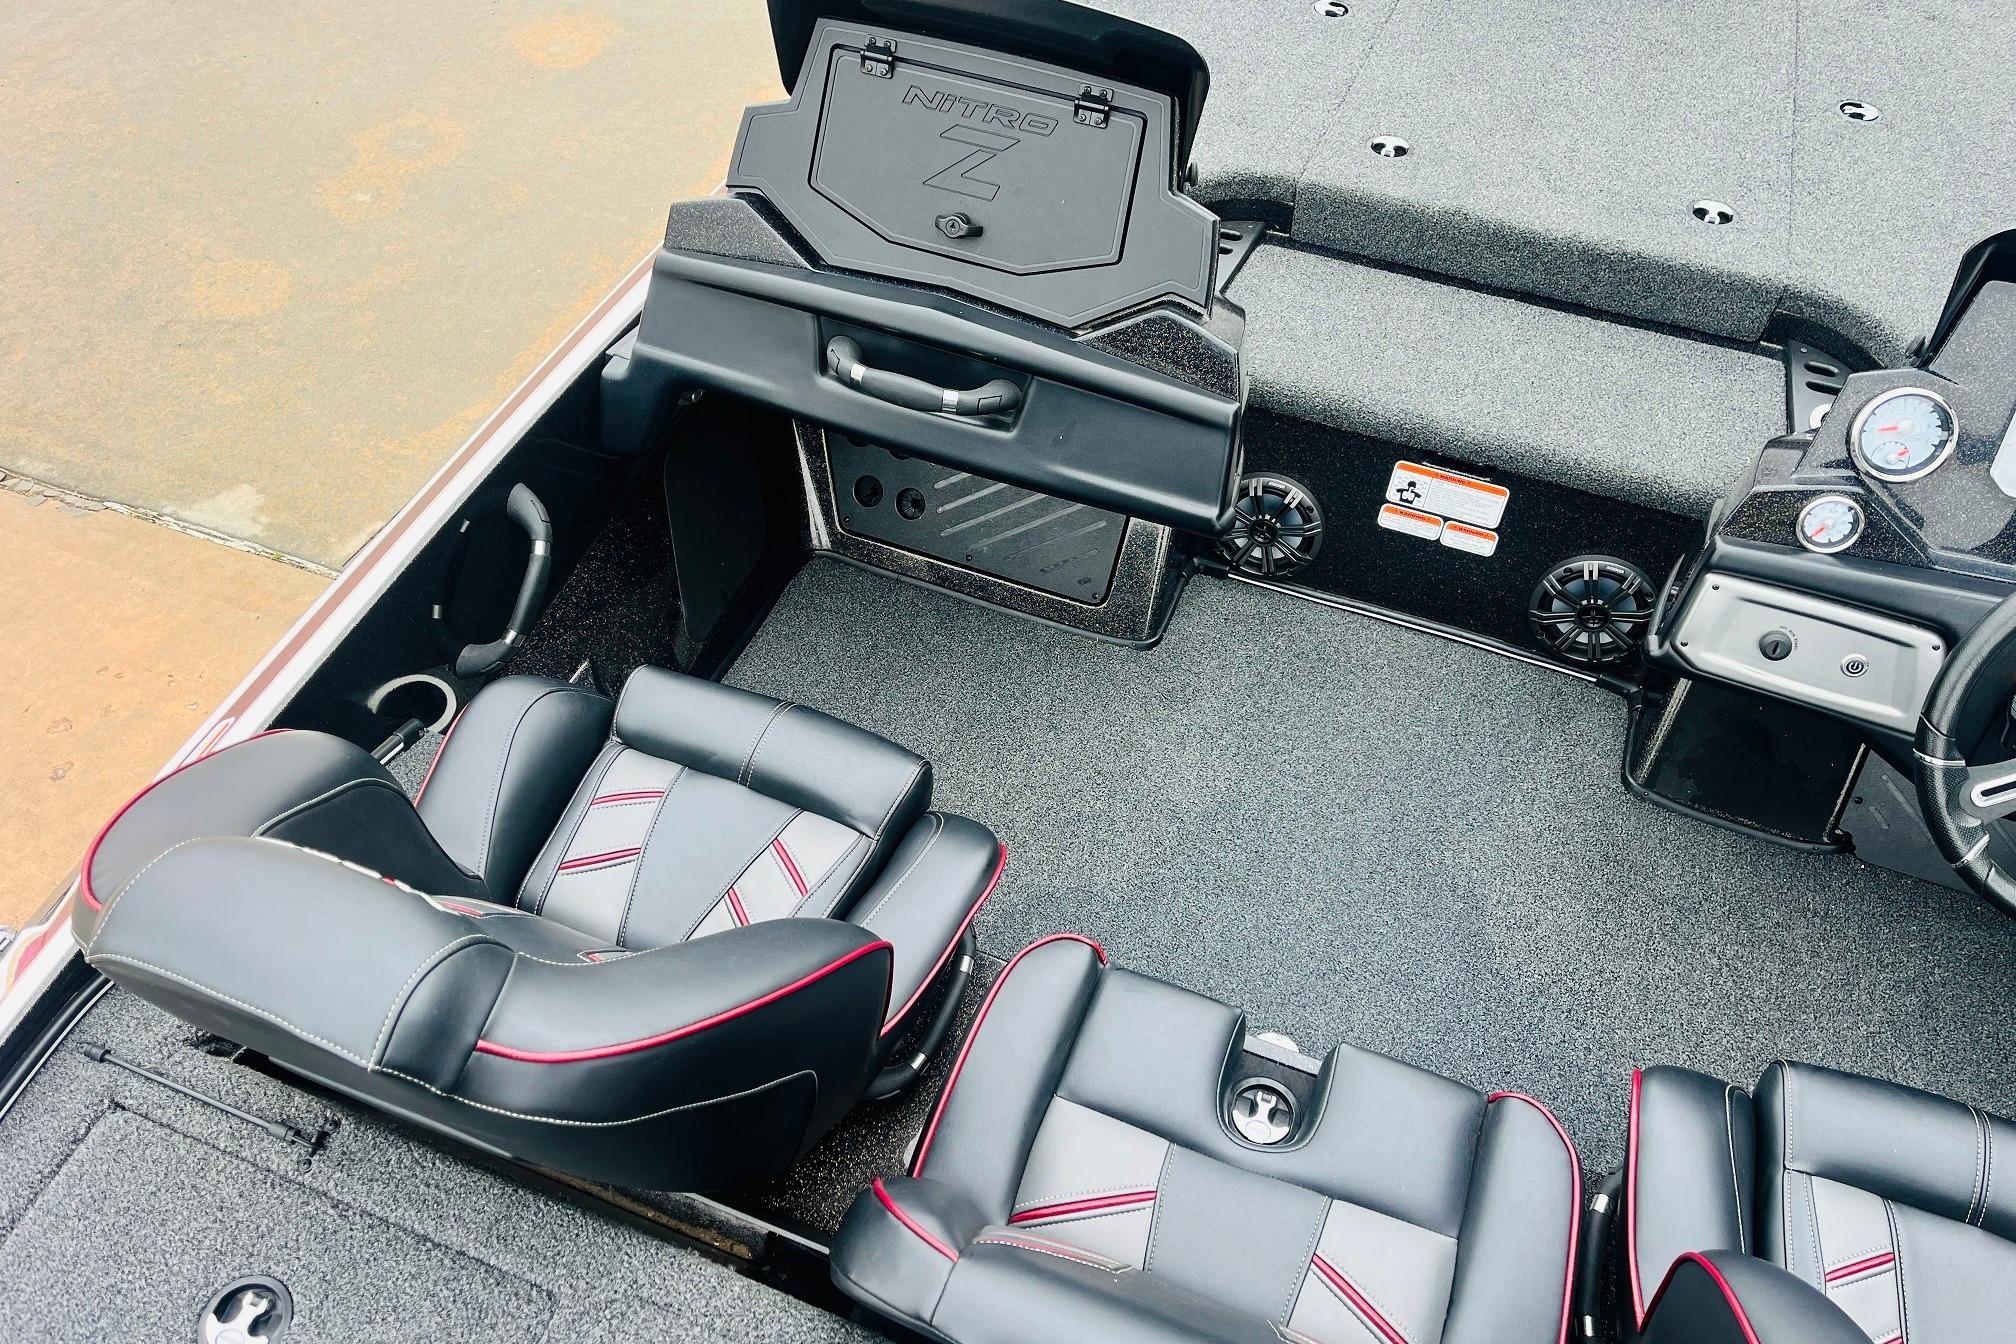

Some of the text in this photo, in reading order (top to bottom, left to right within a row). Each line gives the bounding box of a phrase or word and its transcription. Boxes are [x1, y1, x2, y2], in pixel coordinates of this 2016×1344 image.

[902, 84, 1059, 137] NITRO
[922, 123, 1021, 202] Z
[1439, 474, 1466, 485] WARNING
